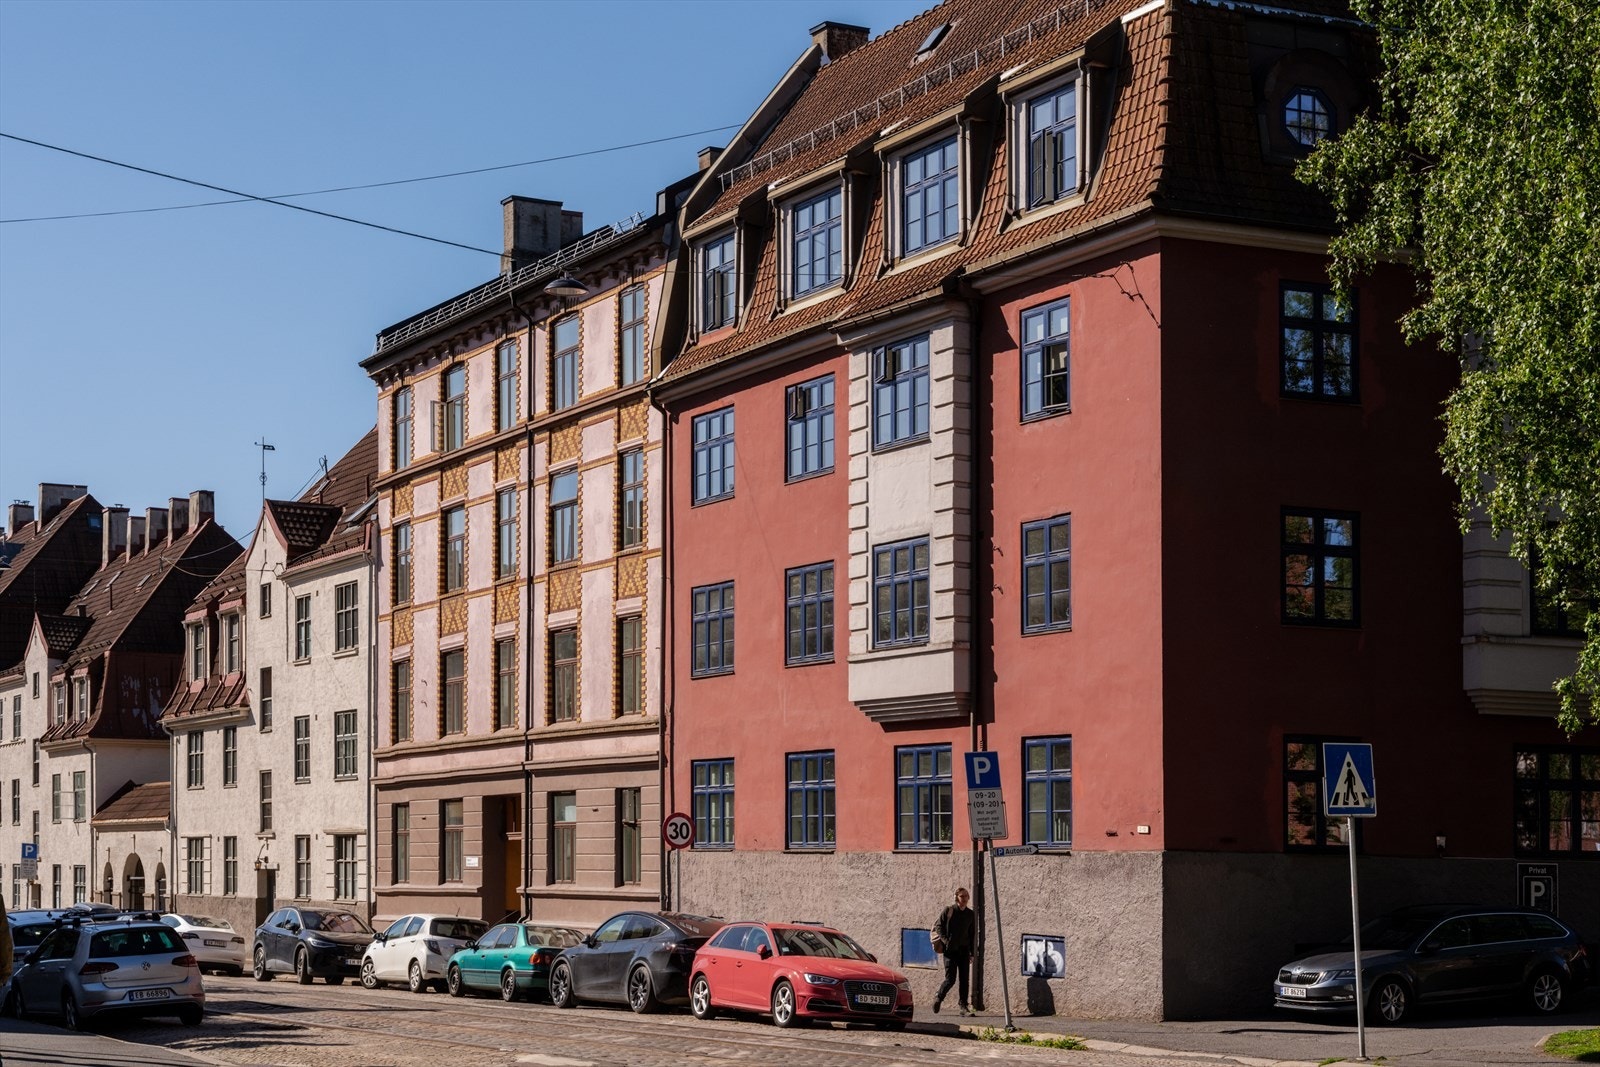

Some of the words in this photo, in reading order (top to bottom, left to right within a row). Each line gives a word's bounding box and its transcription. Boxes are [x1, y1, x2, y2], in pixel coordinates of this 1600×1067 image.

[973, 756, 991, 785] P
[975, 791, 996, 799] 09-20
[973, 800, 1000, 808] (09-20)
[669, 822, 690, 840] 30
[25, 845, 34, 856] P
[1005, 847, 1032, 855] Automat
[1528, 866, 1547, 874] Privat
[1531, 881, 1545, 906] P
